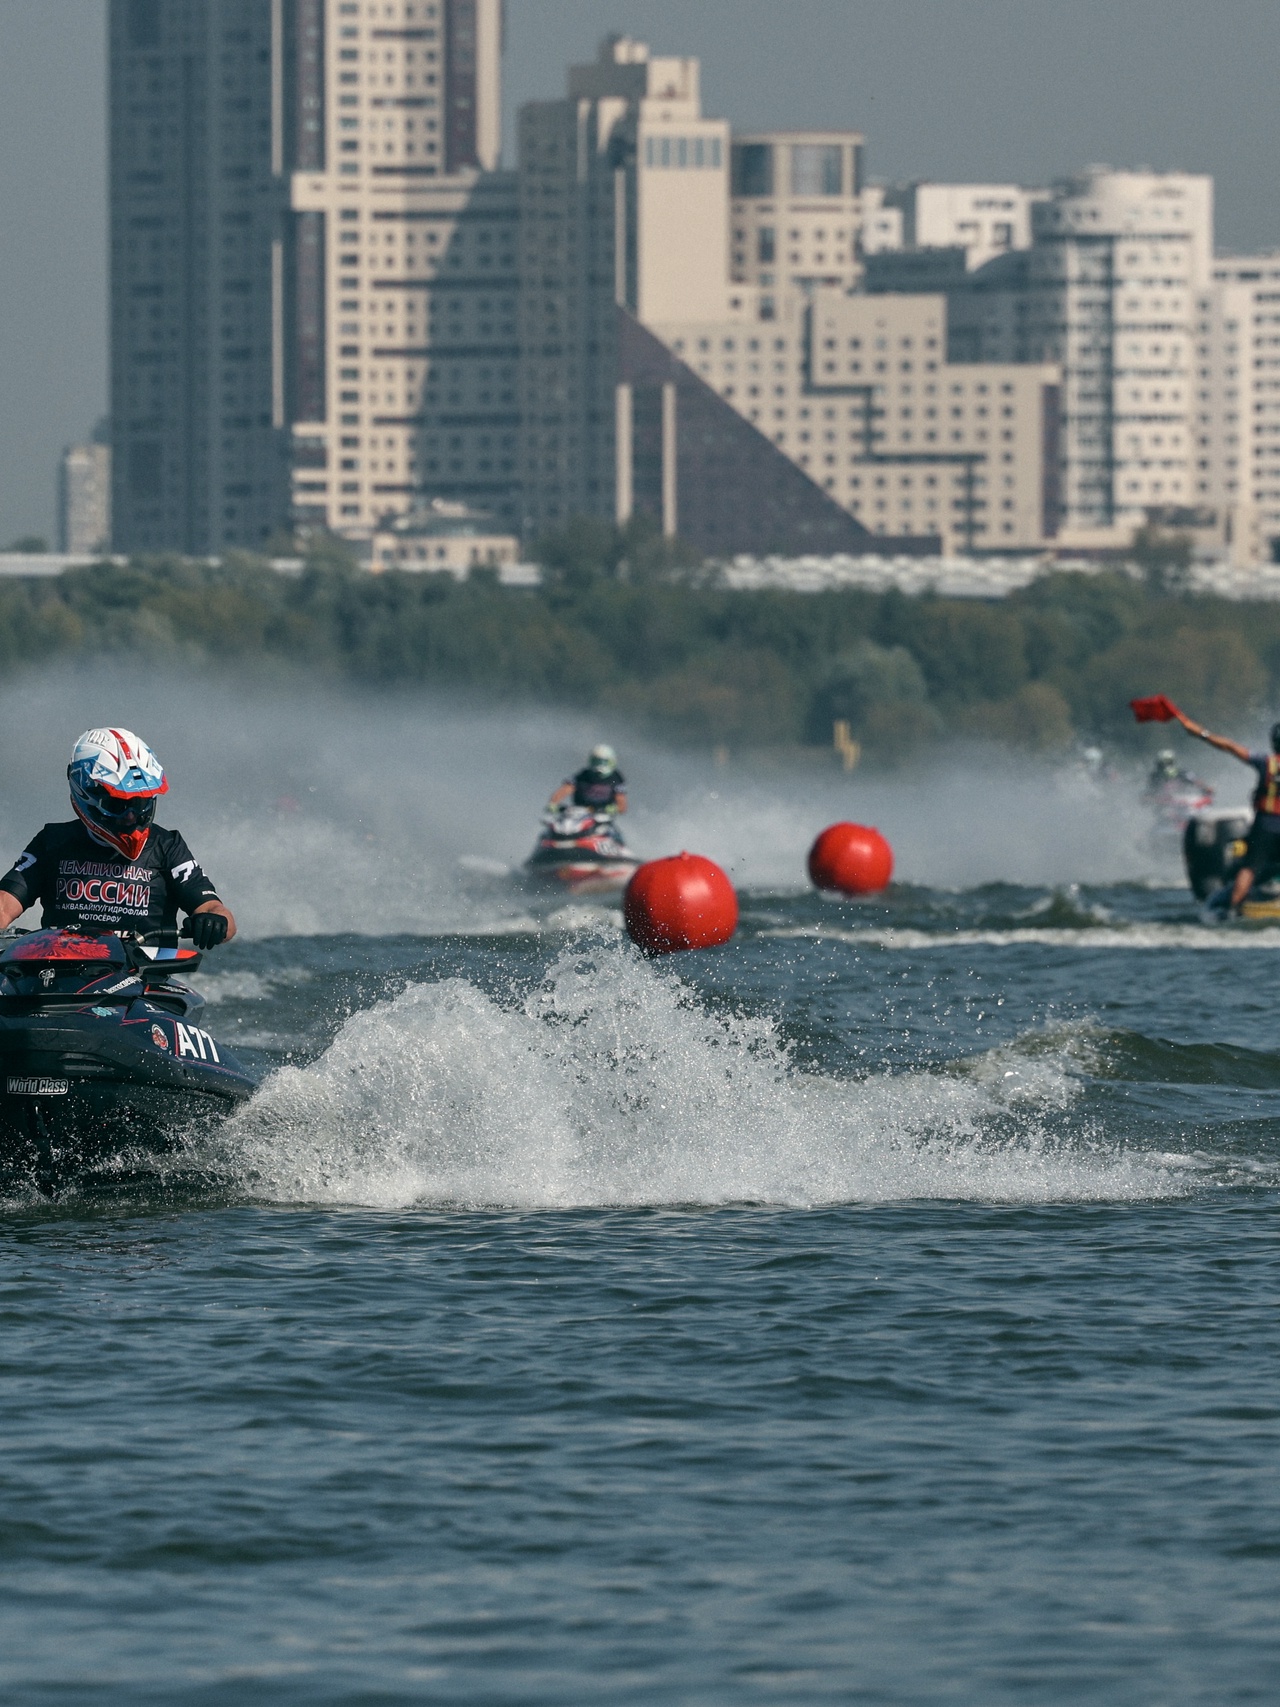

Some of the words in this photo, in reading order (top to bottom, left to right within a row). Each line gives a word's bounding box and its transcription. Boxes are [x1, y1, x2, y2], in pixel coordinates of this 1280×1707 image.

[55, 877, 151, 908] РОССИИ
[176, 1021, 220, 1063] A77
[8, 1078, 38, 1093] World
[38, 1079, 67, 1093] Class
